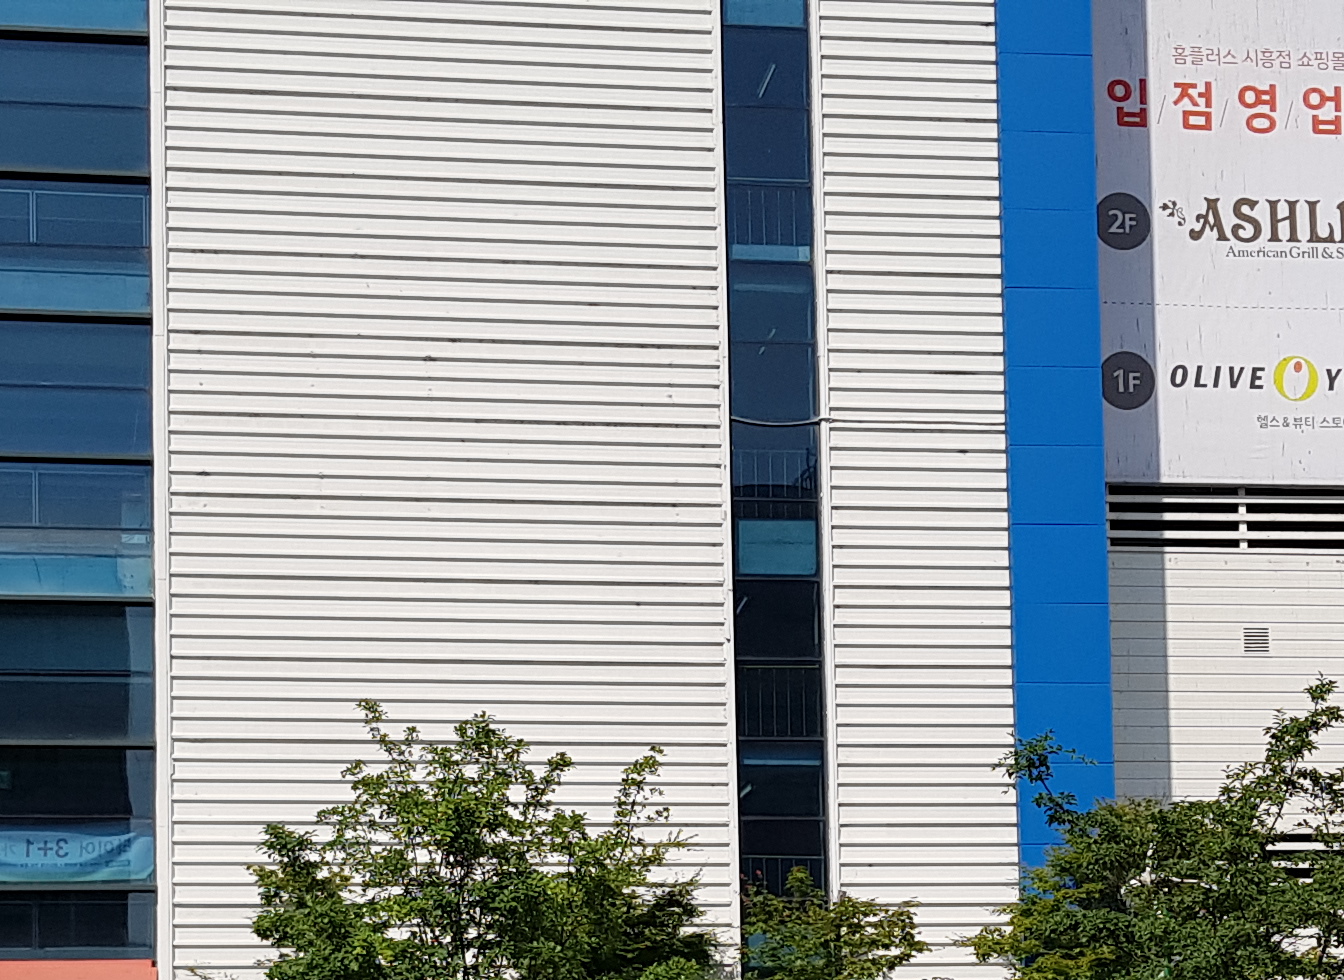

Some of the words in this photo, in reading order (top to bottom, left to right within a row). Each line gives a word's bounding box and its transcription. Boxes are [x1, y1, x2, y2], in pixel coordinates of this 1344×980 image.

[1172, 44, 1238, 66] 홈플러스
[1242, 48, 1292, 69] 시흥점
[1108, 209, 1137, 234] 2F
[1225, 246, 1288, 260] American
[1289, 247, 1319, 260] Grill
[1321, 248, 1334, 259] &
[1113, 368, 1141, 393] 1F
[1170, 364, 1266, 390] OLIVE
